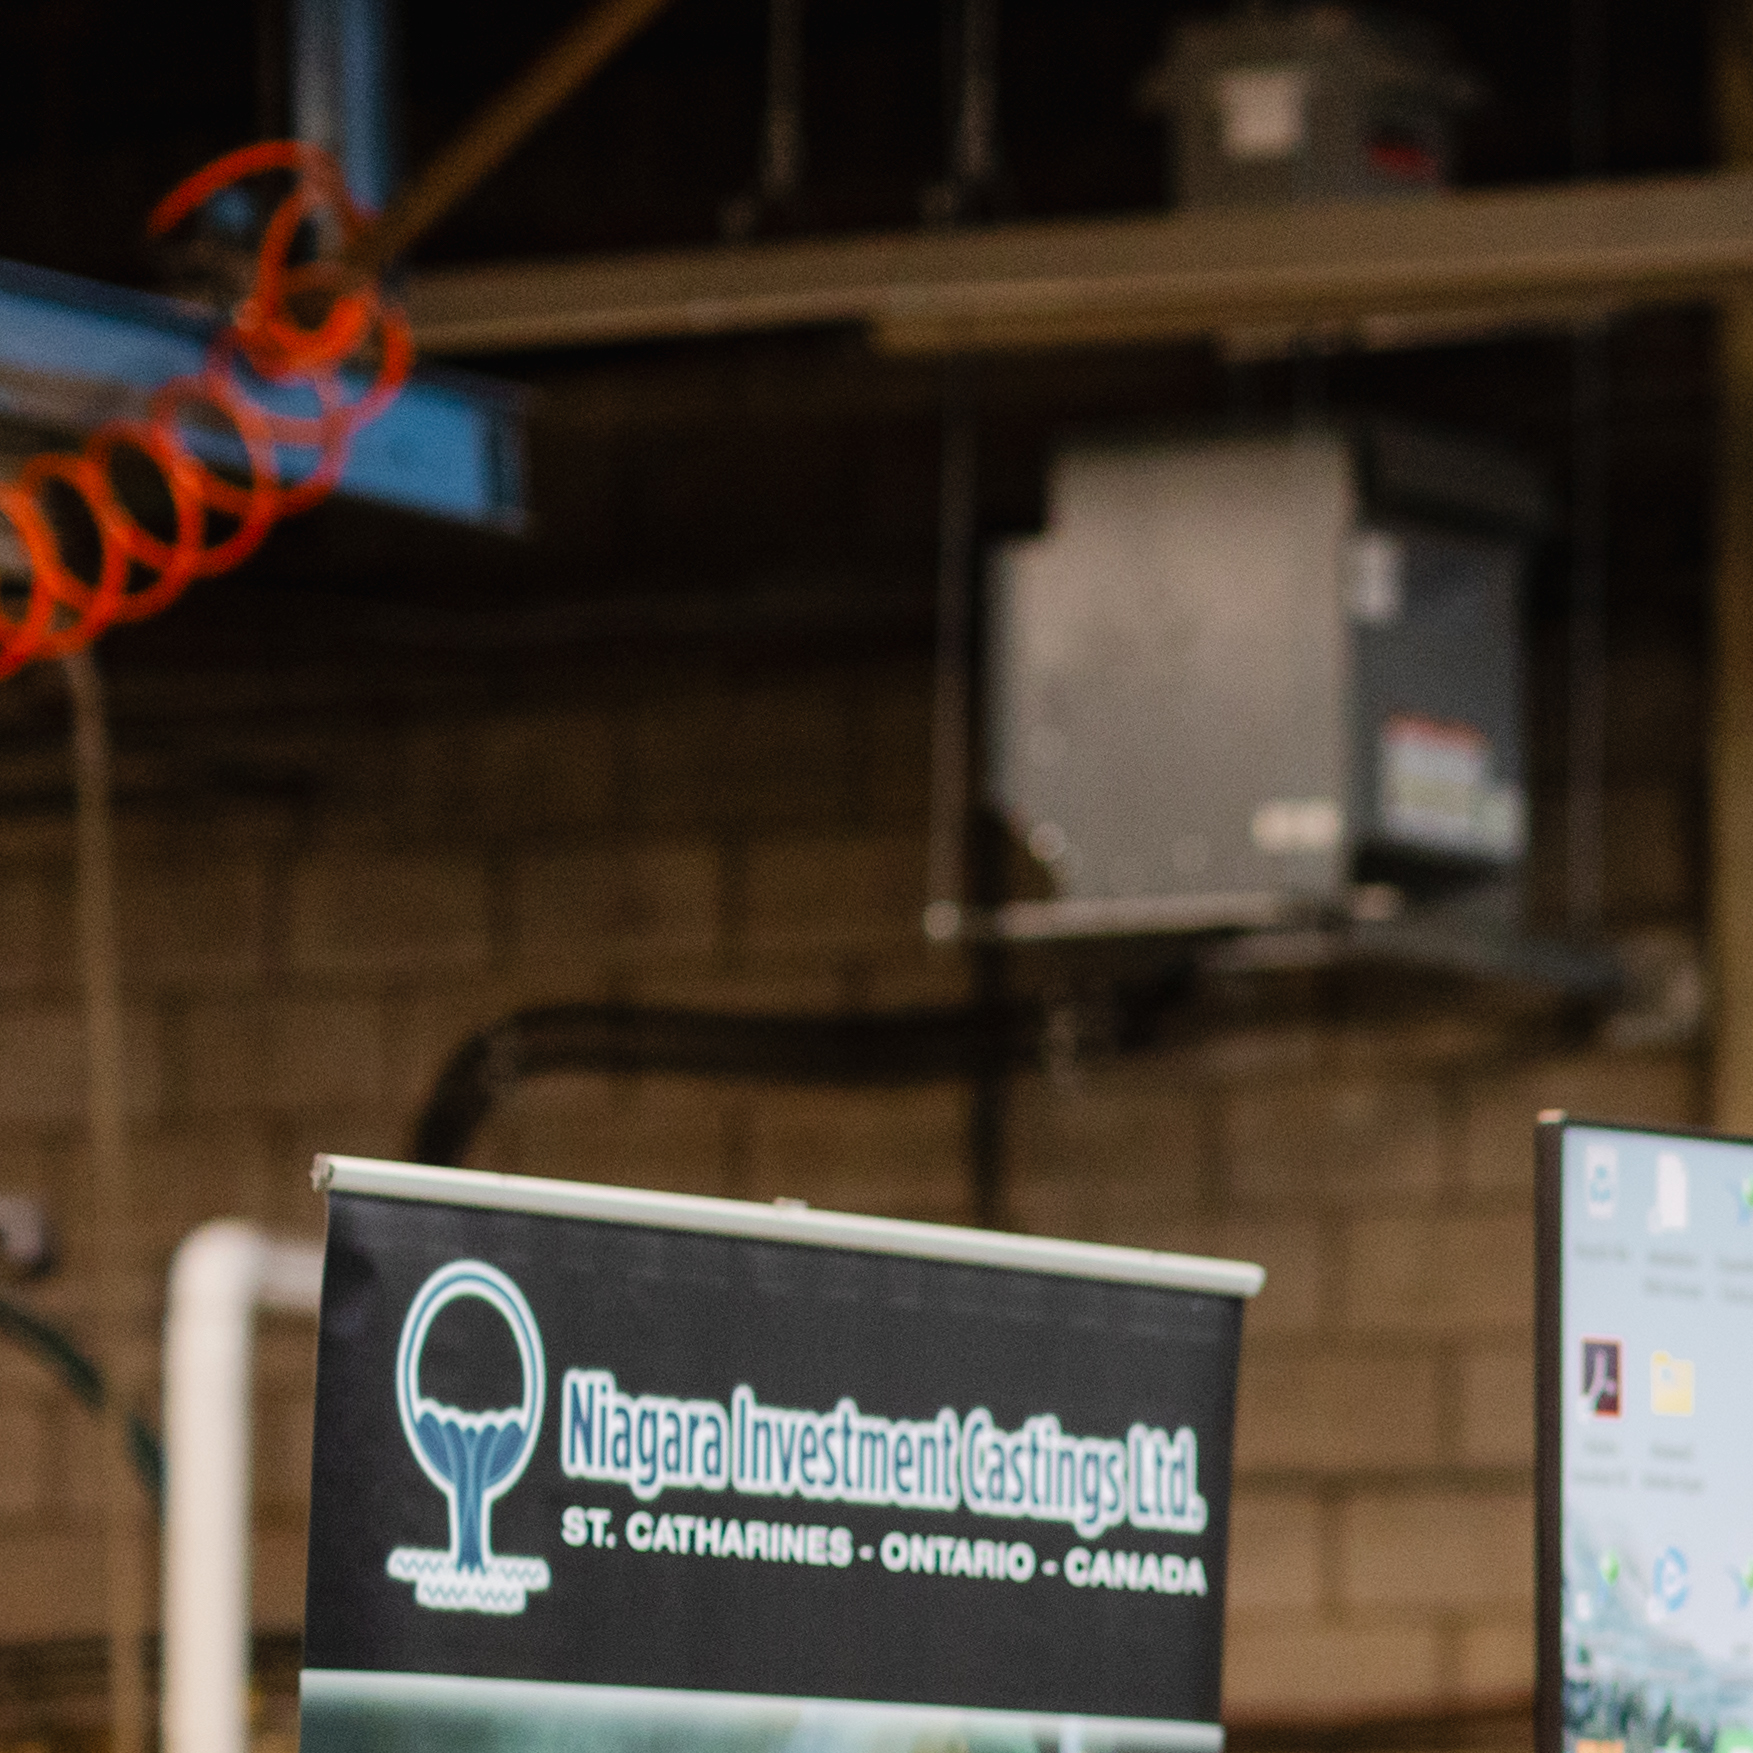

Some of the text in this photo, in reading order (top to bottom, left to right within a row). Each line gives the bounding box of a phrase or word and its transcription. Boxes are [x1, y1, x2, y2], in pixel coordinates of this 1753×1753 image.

[564, 1371, 1205, 1536] Niagara Investment Castings Ltd.
[561, 1506, 1208, 1596] ST. CATHARINES ONTARIO CANADA
